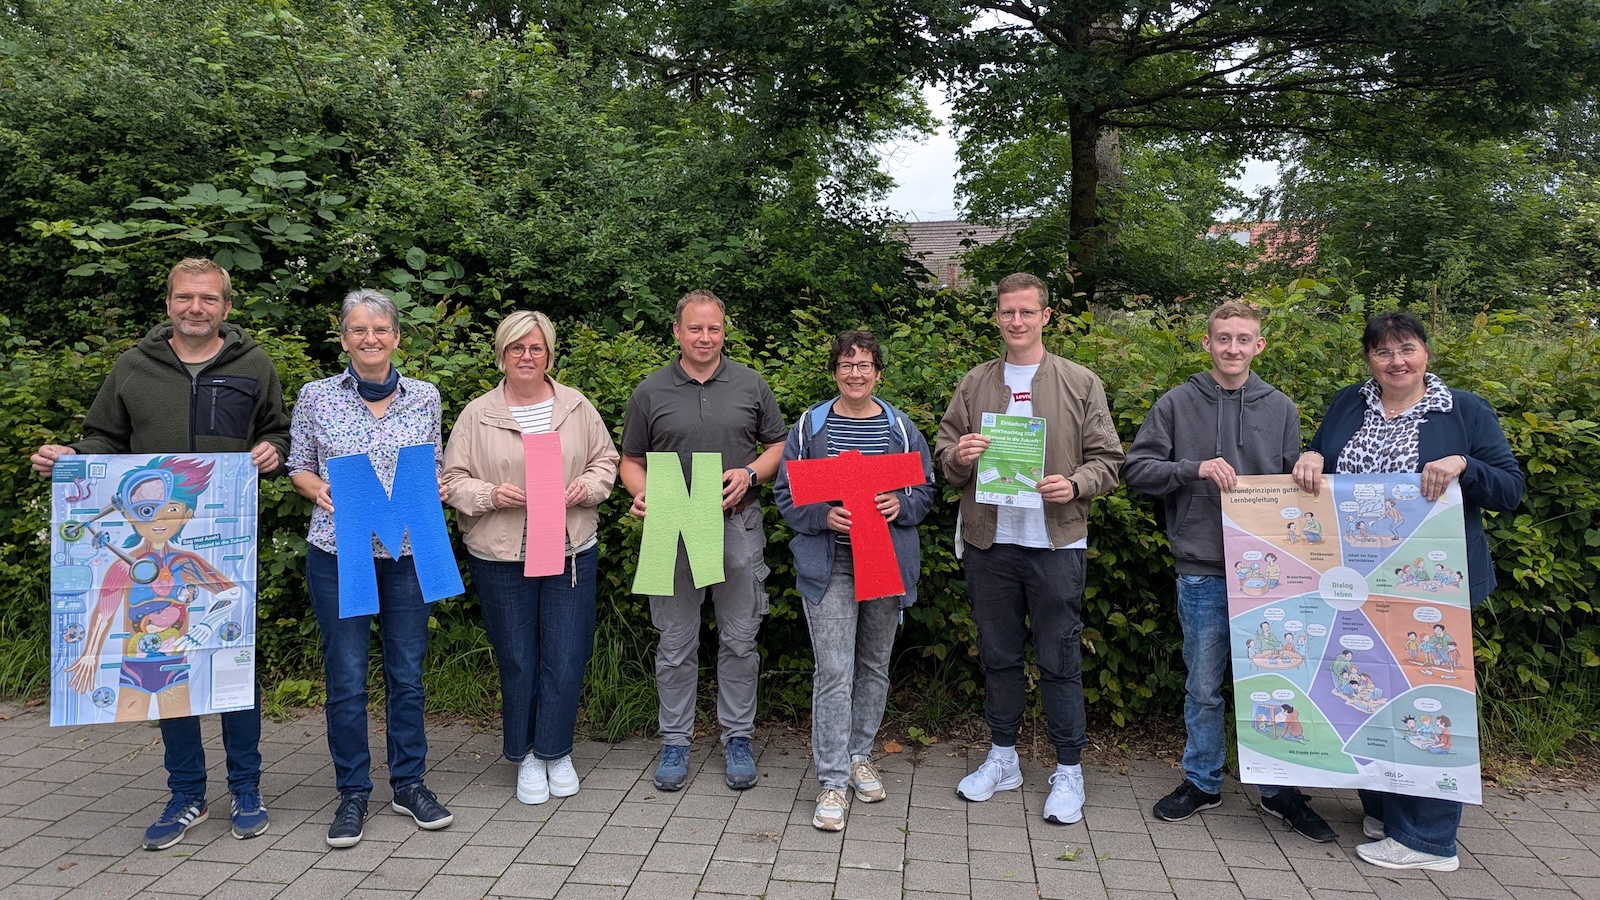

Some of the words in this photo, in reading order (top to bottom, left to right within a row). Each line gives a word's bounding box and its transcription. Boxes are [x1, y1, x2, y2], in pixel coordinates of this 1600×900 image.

[990, 428, 1023, 436] MINTmachtag
[1282, 487, 1300, 495] guter
[1230, 496, 1279, 504] Lernbegleitung
[1331, 581, 1354, 591] Dialog
[1333, 590, 1353, 599] leben
[1366, 736, 1388, 744] Beziehung
